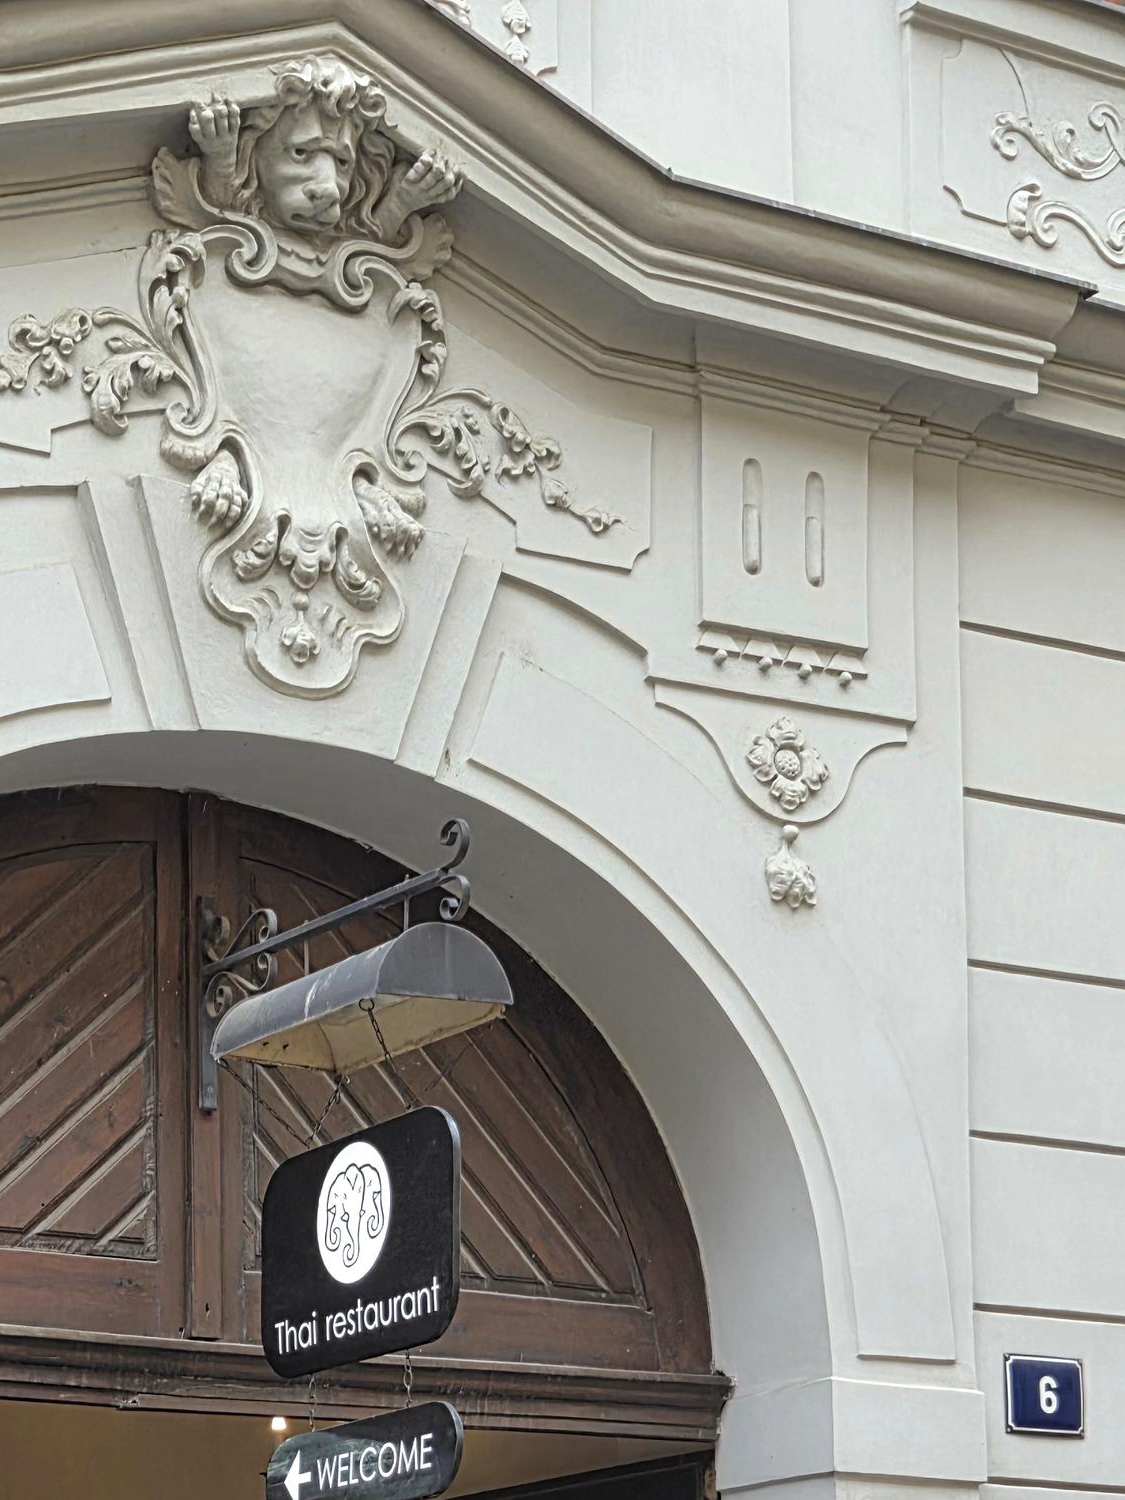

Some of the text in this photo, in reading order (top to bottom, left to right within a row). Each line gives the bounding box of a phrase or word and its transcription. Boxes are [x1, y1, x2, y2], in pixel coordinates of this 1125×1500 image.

[275, 1276, 440, 1356] Thai restaurant
[1039, 1376, 1058, 1414] 6
[317, 1432, 433, 1491] WELCOME
